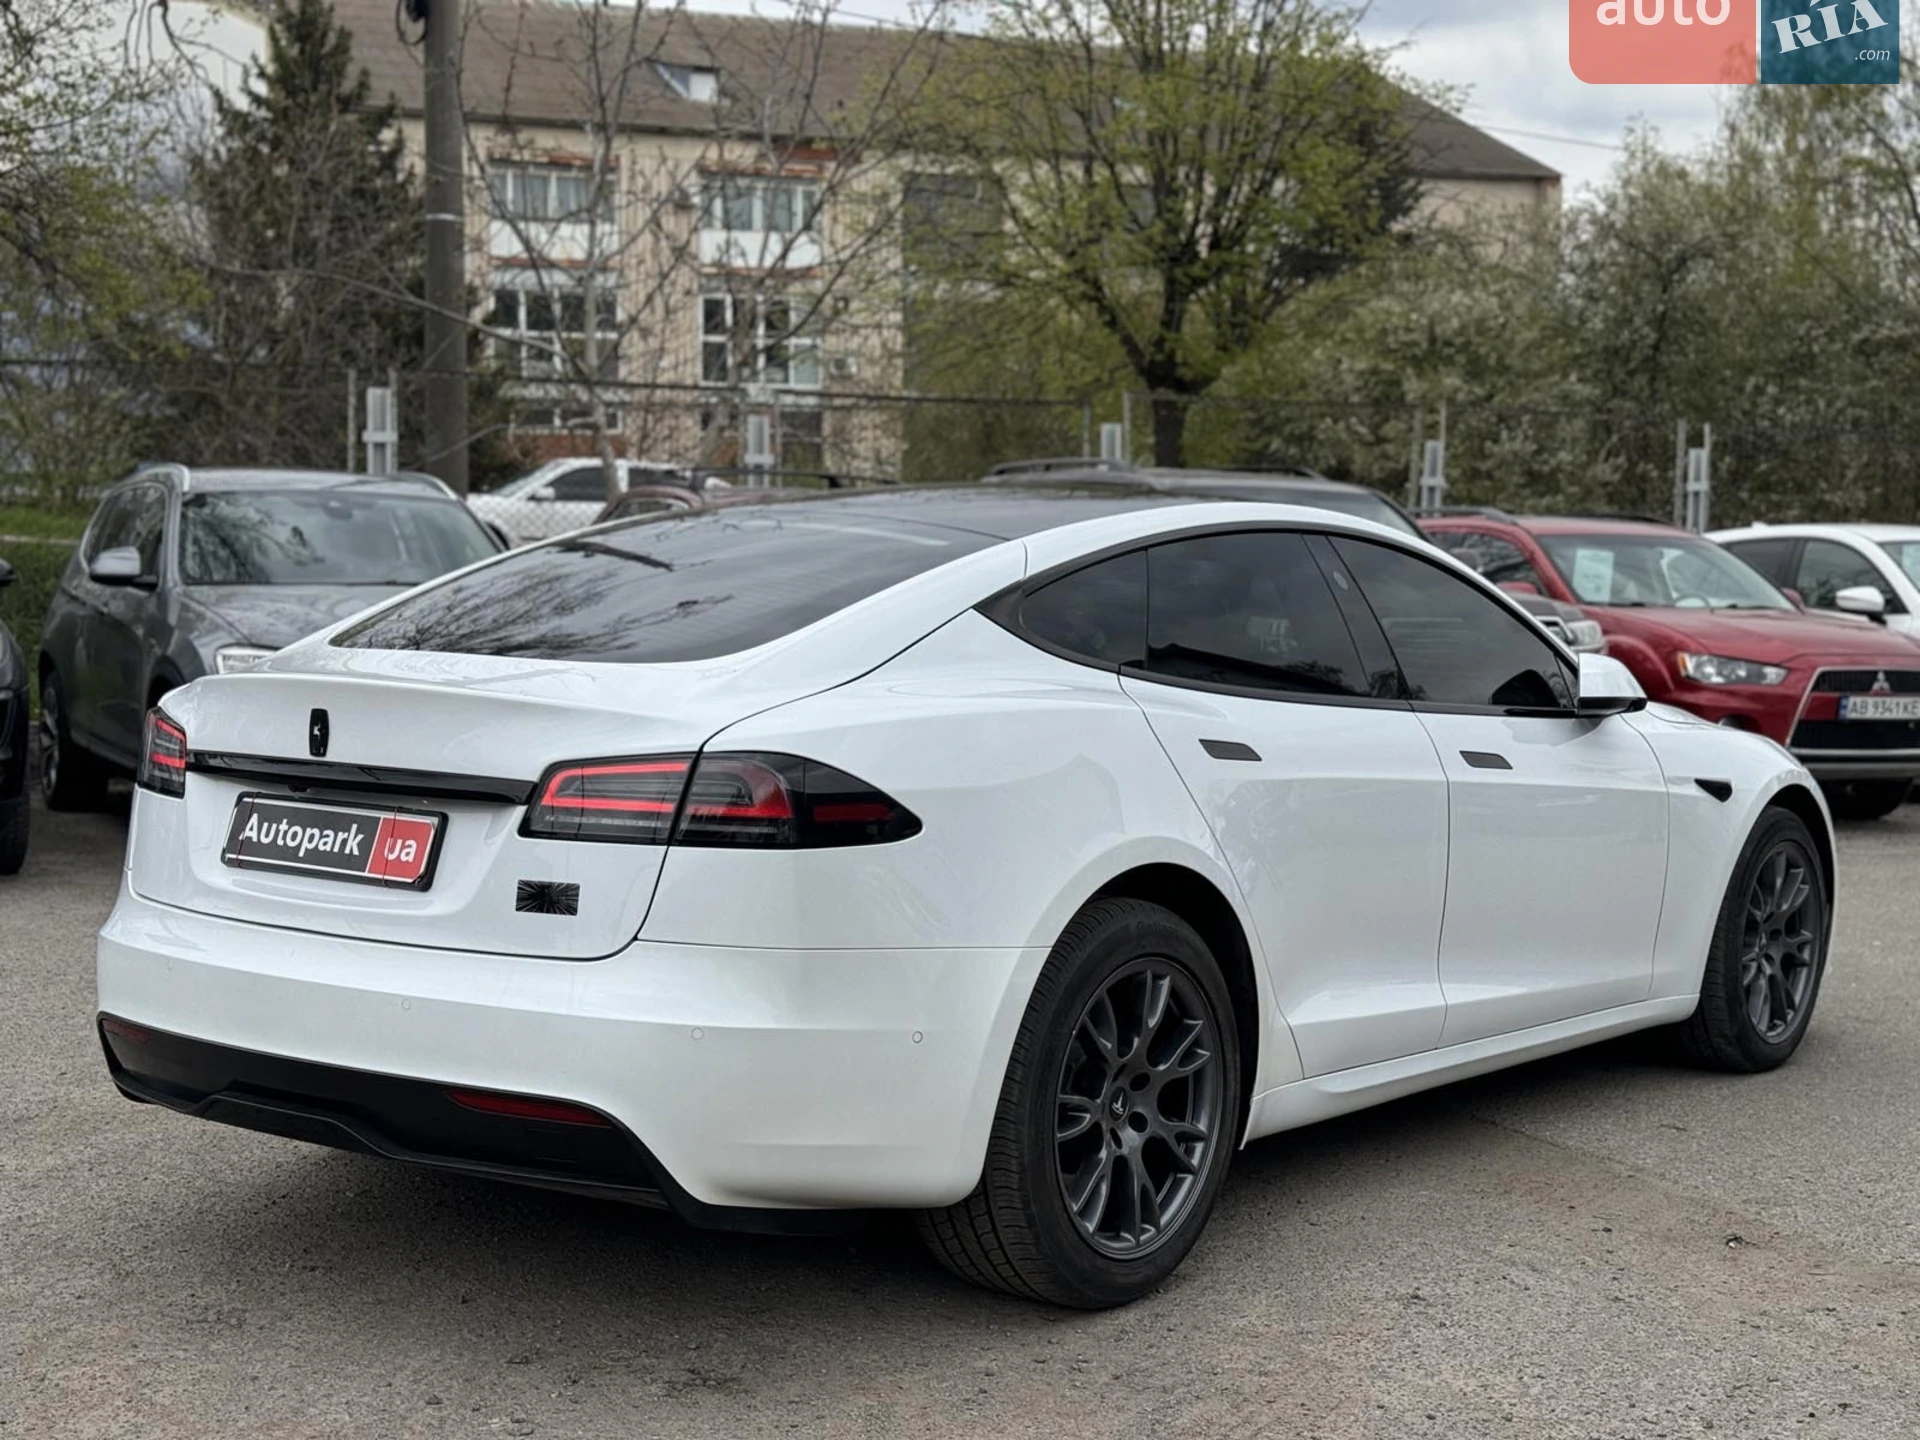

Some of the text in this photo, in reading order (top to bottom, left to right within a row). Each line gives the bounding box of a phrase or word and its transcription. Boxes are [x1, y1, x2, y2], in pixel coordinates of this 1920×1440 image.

[1850, 700, 1868, 715] AB
[239, 813, 417, 862] Autopark ua
